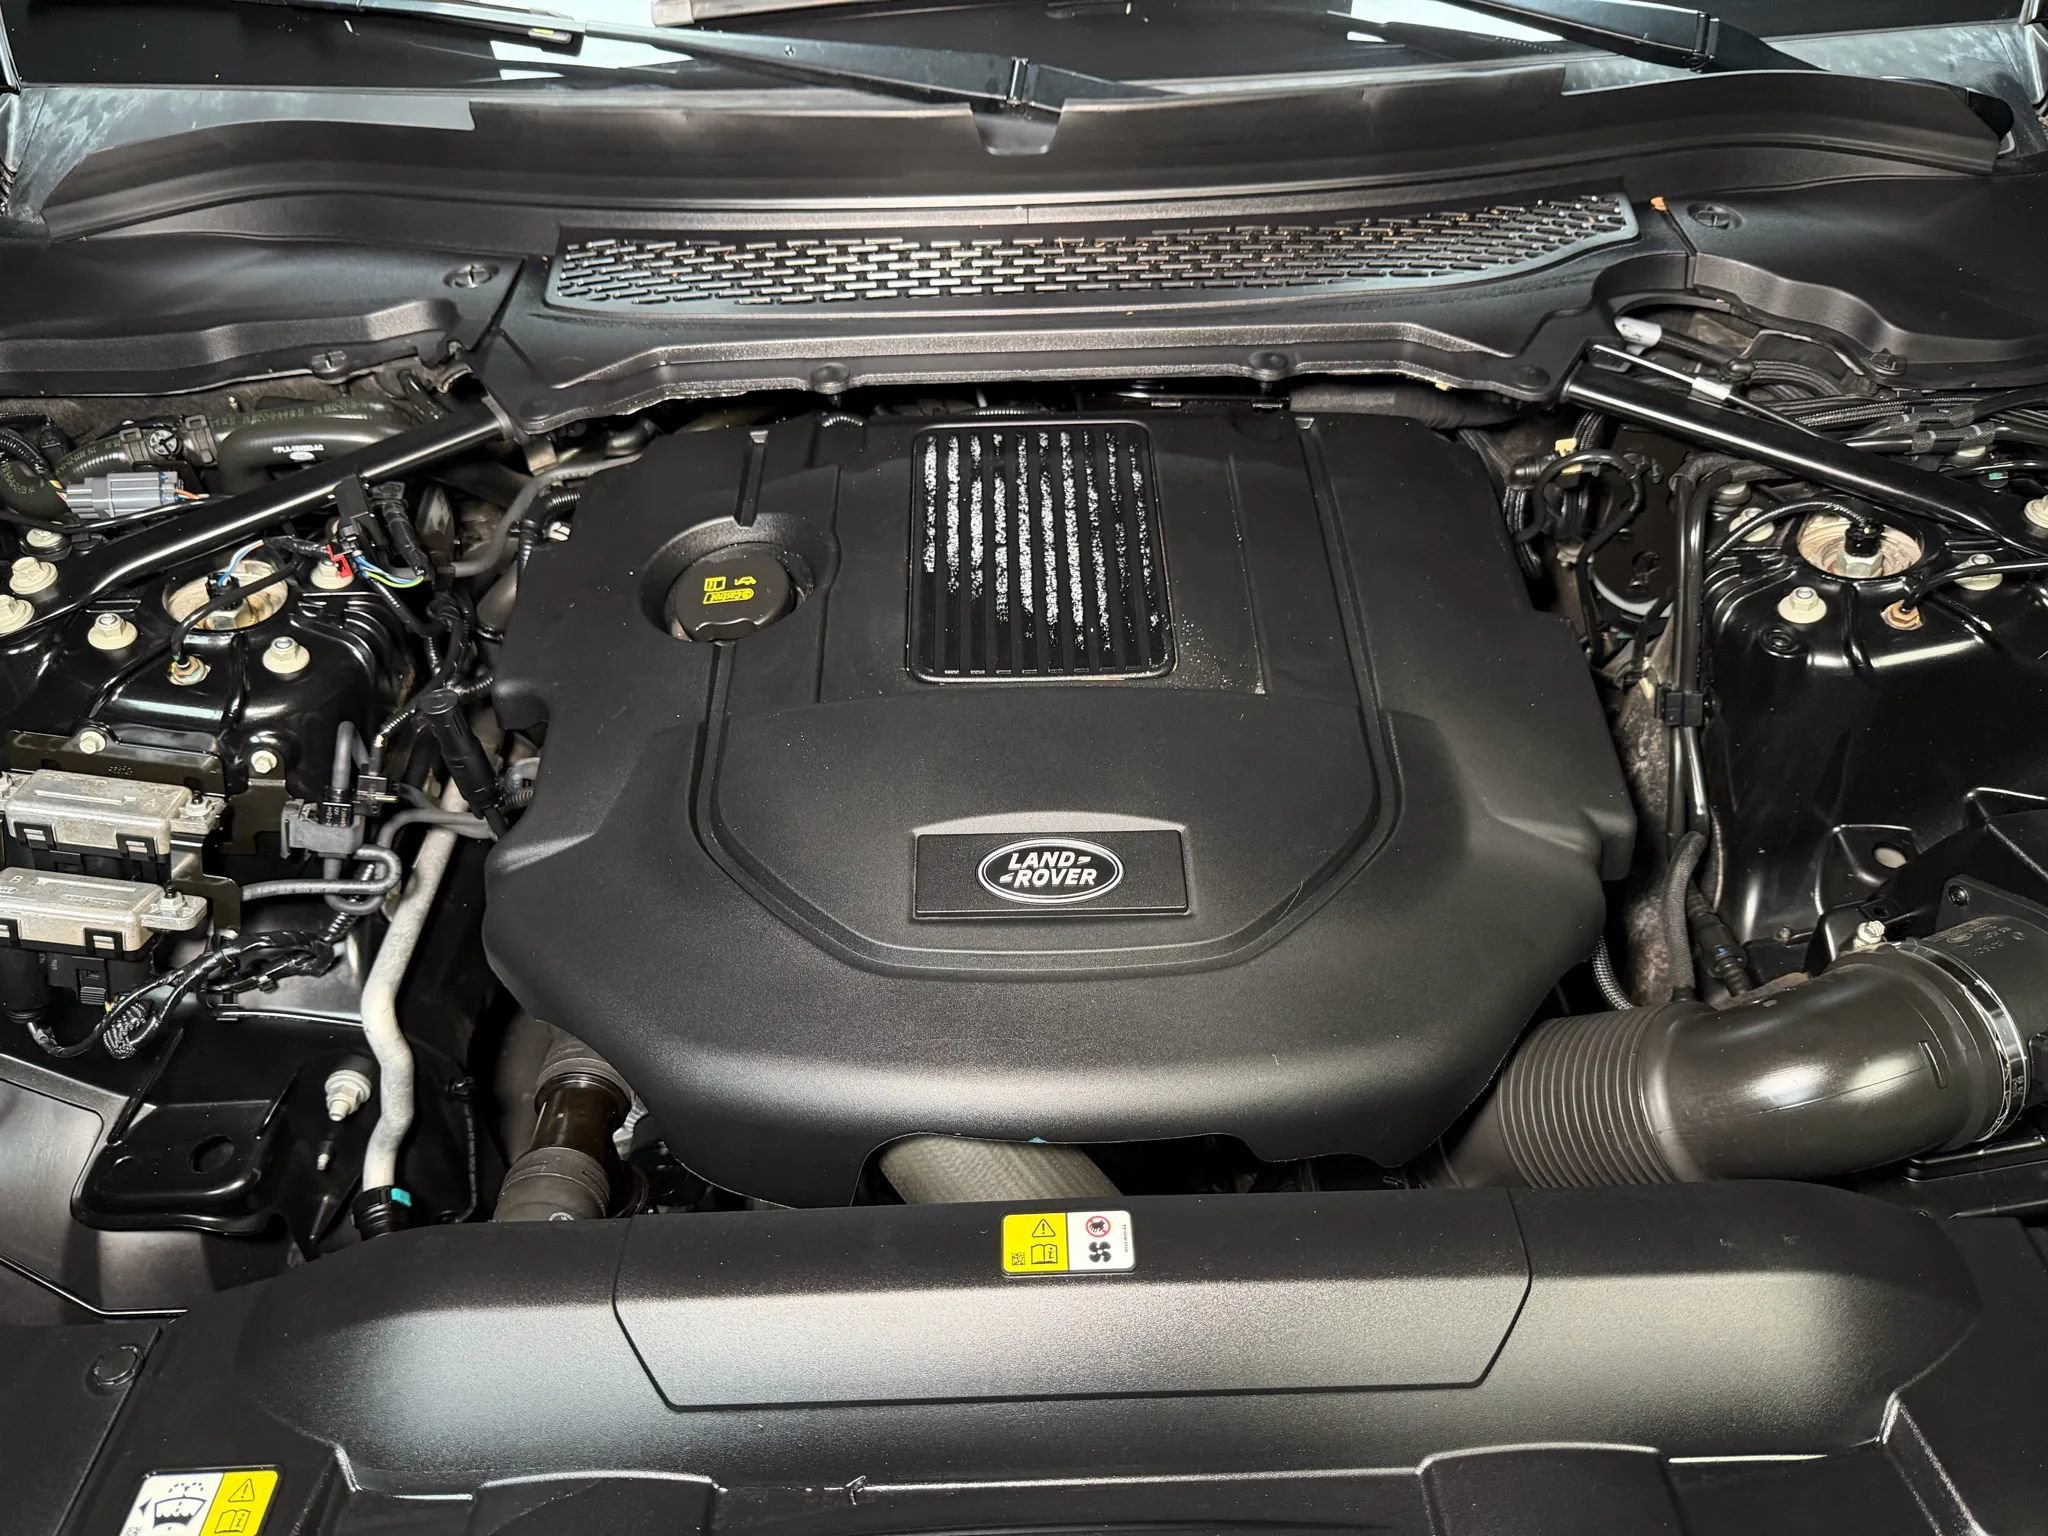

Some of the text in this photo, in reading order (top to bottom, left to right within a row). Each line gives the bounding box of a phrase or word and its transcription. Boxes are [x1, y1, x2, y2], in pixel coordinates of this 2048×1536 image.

[1008, 851, 1076, 871] LAND
[9, 875, 24, 884] B
[1013, 867, 1098, 889] ROVER
